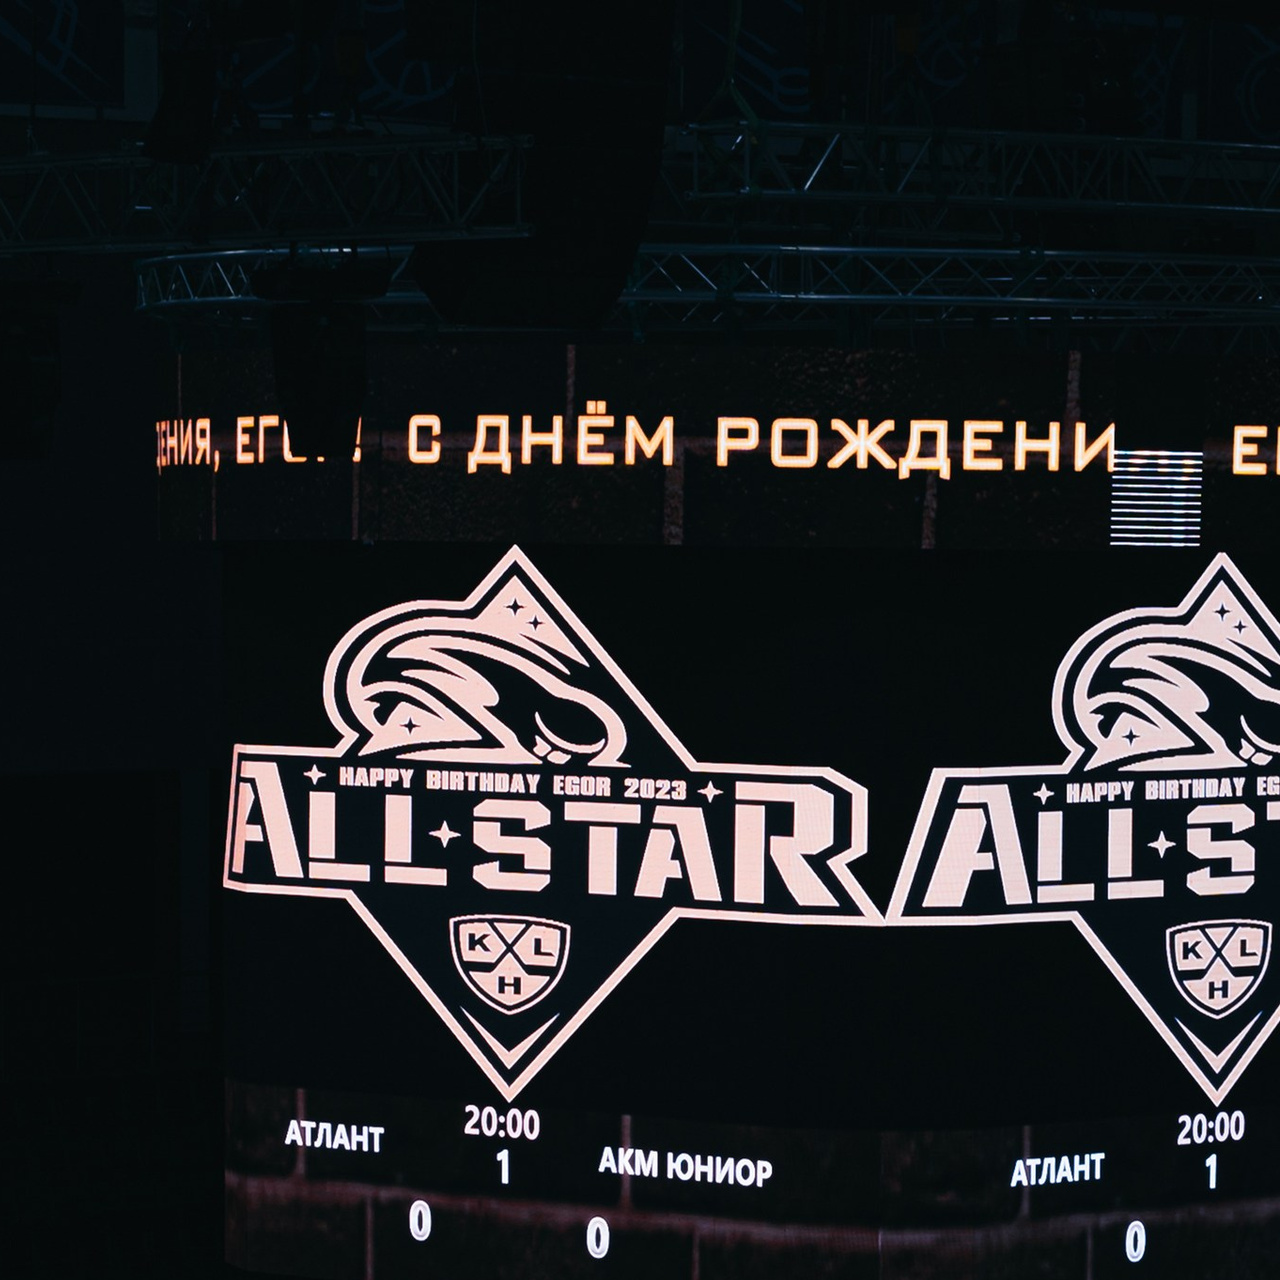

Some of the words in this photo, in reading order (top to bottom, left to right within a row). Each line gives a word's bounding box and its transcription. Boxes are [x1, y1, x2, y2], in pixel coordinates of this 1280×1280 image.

[408, 414, 441, 464] С
[467, 400, 674, 475] ДНЁМ
[716, 416, 1117, 480] РОЖДЕНИ
[338, 765, 415, 789] HAPPY
[426, 769, 542, 796] BIRTHDAY
[552, 773, 611, 799] EGOR
[624, 776, 688, 801] 2023
[1066, 779, 1134, 804] HAPPY
[1145, 775, 1245, 801] BIRTHDAY
[285, 1119, 385, 1154] АТЛАНТ
[463, 1104, 541, 1142] 20:00
[1176, 1110, 1246, 1146] 20:00
[496, 1149, 511, 1185] 1
[598, 1145, 659, 1178] АКМ
[666, 1151, 773, 1189] ЮНИОР
[1009, 1152, 1106, 1188] АТЛАНТ
[1204, 1152, 1219, 1190] 1
[408, 1199, 433, 1242] 0
[586, 1216, 611, 1259] 0
[1125, 1219, 1147, 1263] 0
